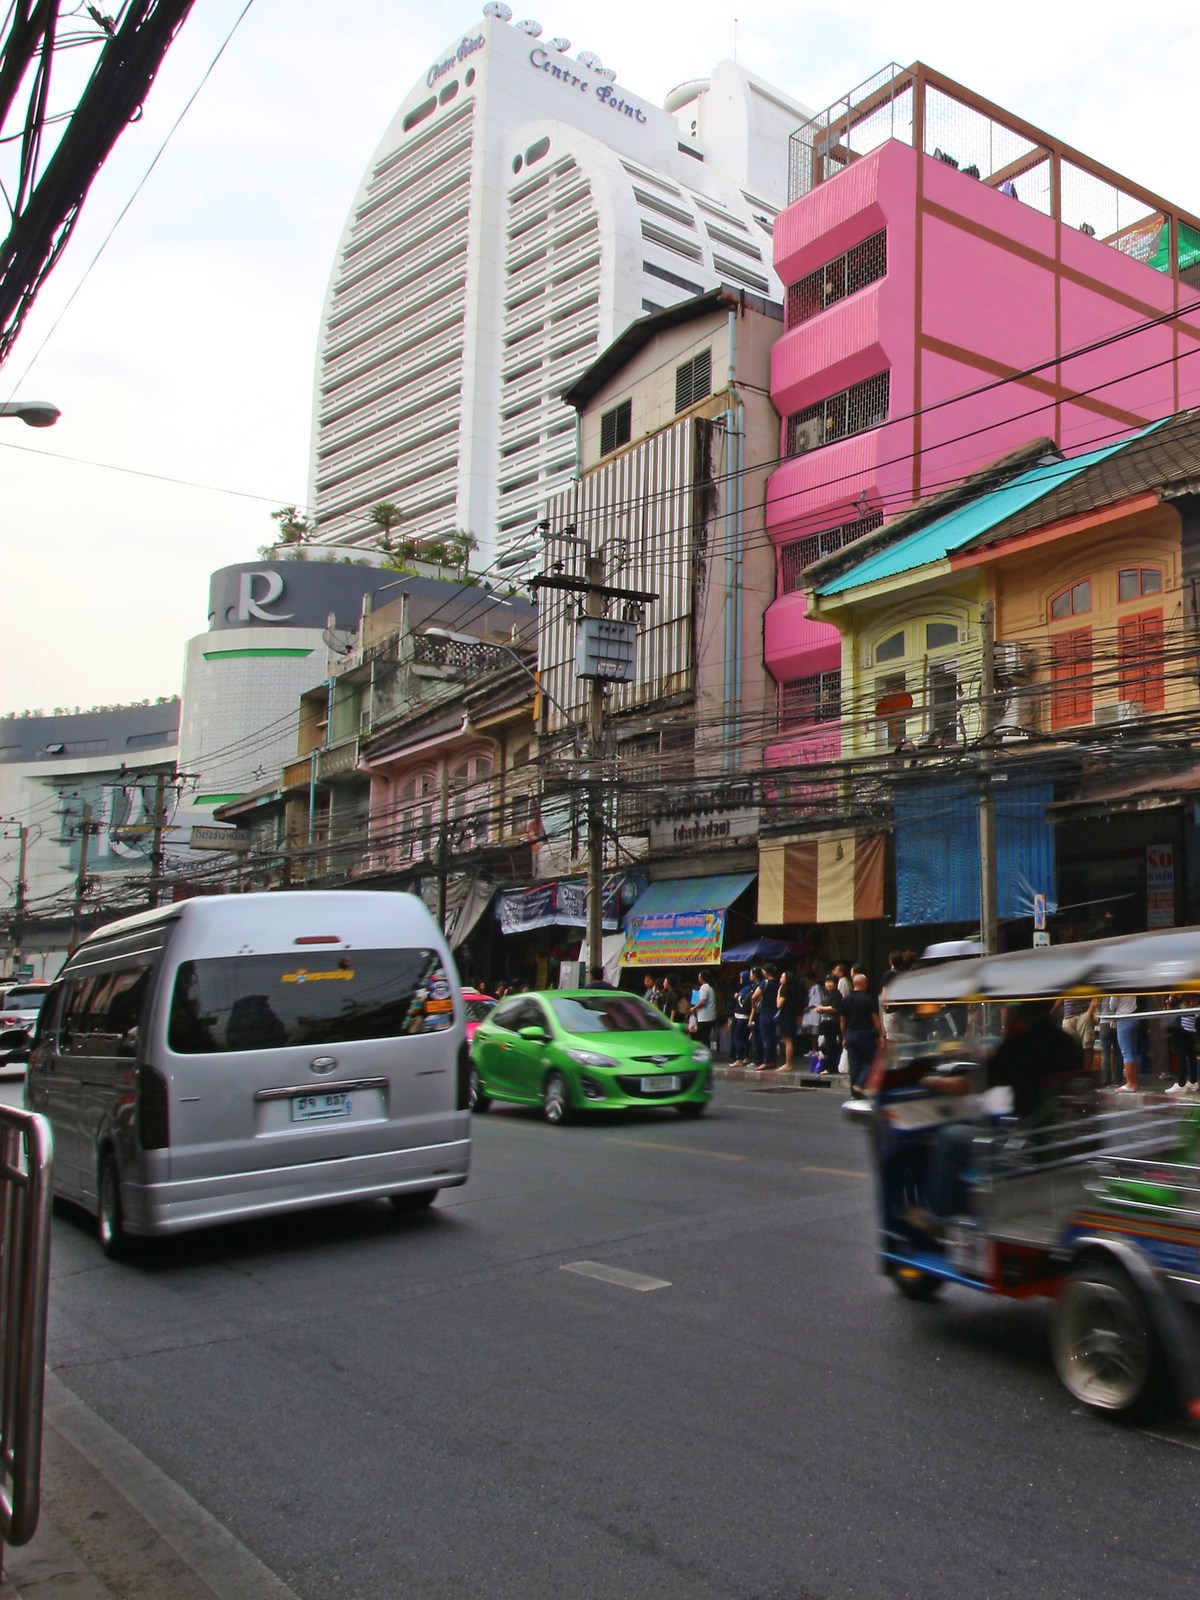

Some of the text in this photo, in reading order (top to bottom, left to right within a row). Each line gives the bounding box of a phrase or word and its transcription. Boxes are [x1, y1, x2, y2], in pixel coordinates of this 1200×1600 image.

[529, 48, 647, 124] Centre Point
[239, 571, 295, 621] R
